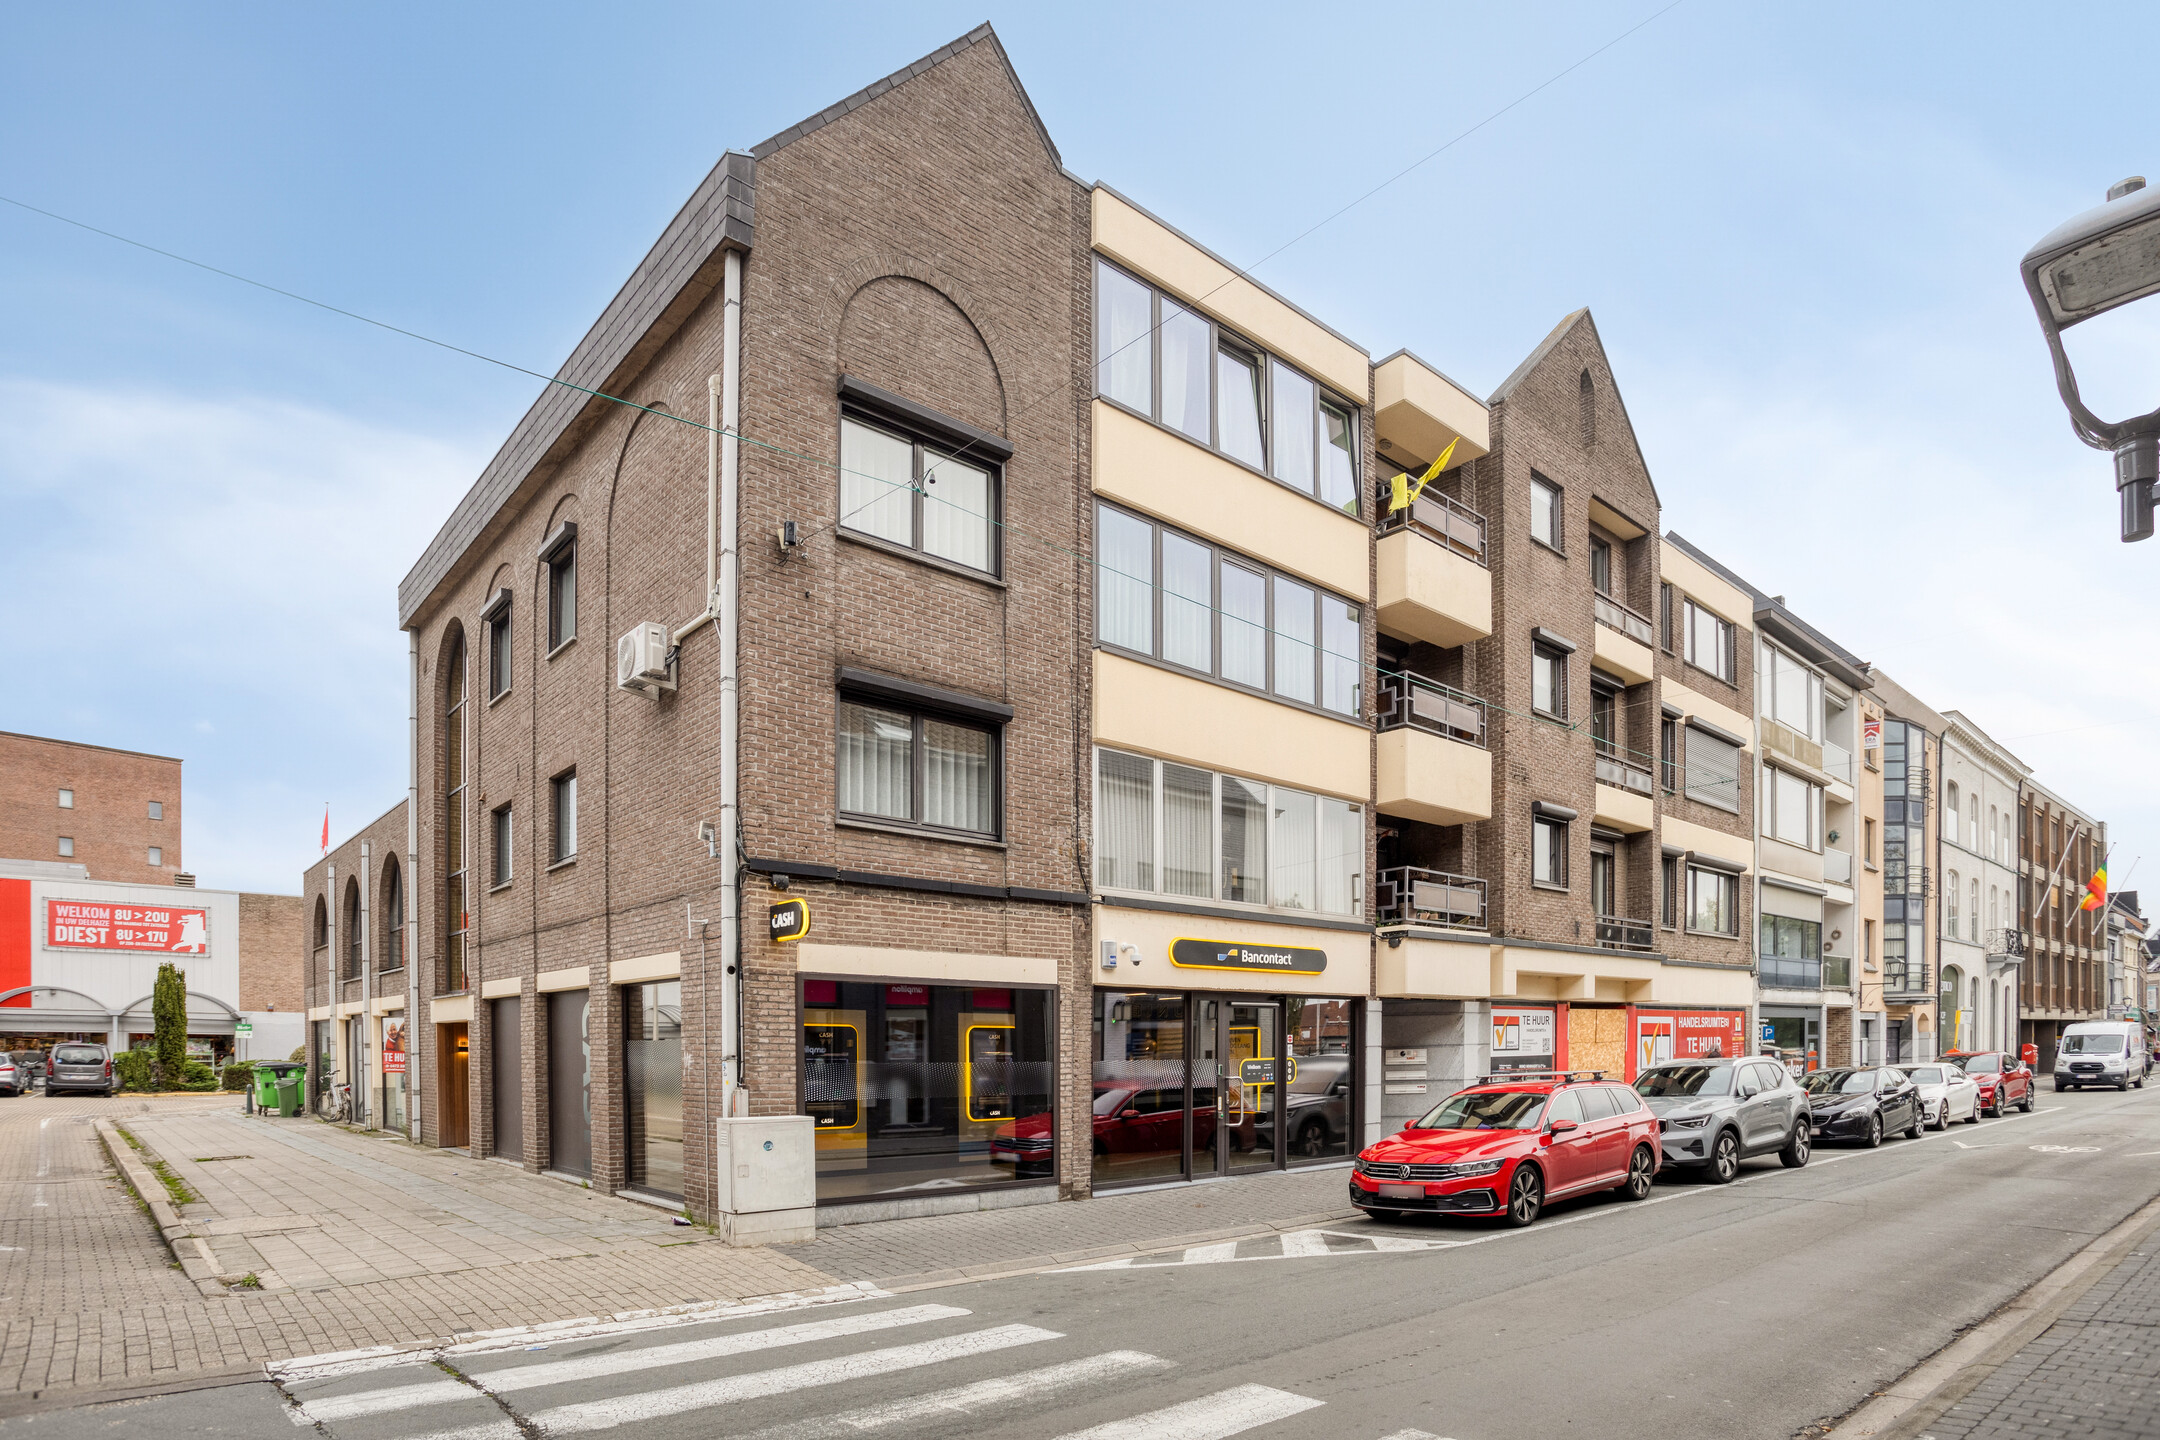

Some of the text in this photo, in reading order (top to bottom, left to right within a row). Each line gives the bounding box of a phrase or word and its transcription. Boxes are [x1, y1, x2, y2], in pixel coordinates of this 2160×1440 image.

[56, 904, 110, 920] WELKOM
[114, 909, 131, 921] 8U
[145, 911, 169, 923] 20U
[772, 911, 794, 928] CASH
[55, 926, 109, 943] DIEST
[116, 929, 133, 940] 8U
[146, 931, 168, 942] 17U
[1242, 950, 1292, 966] Bancontact
[1523, 1016, 1550, 1025] TE HUUR
[1765, 1028, 1773, 1037] P
[1687, 1037, 1697, 1053] TE
[1699, 1037, 1722, 1053] HUUR
[384, 1053, 393, 1062] TE
